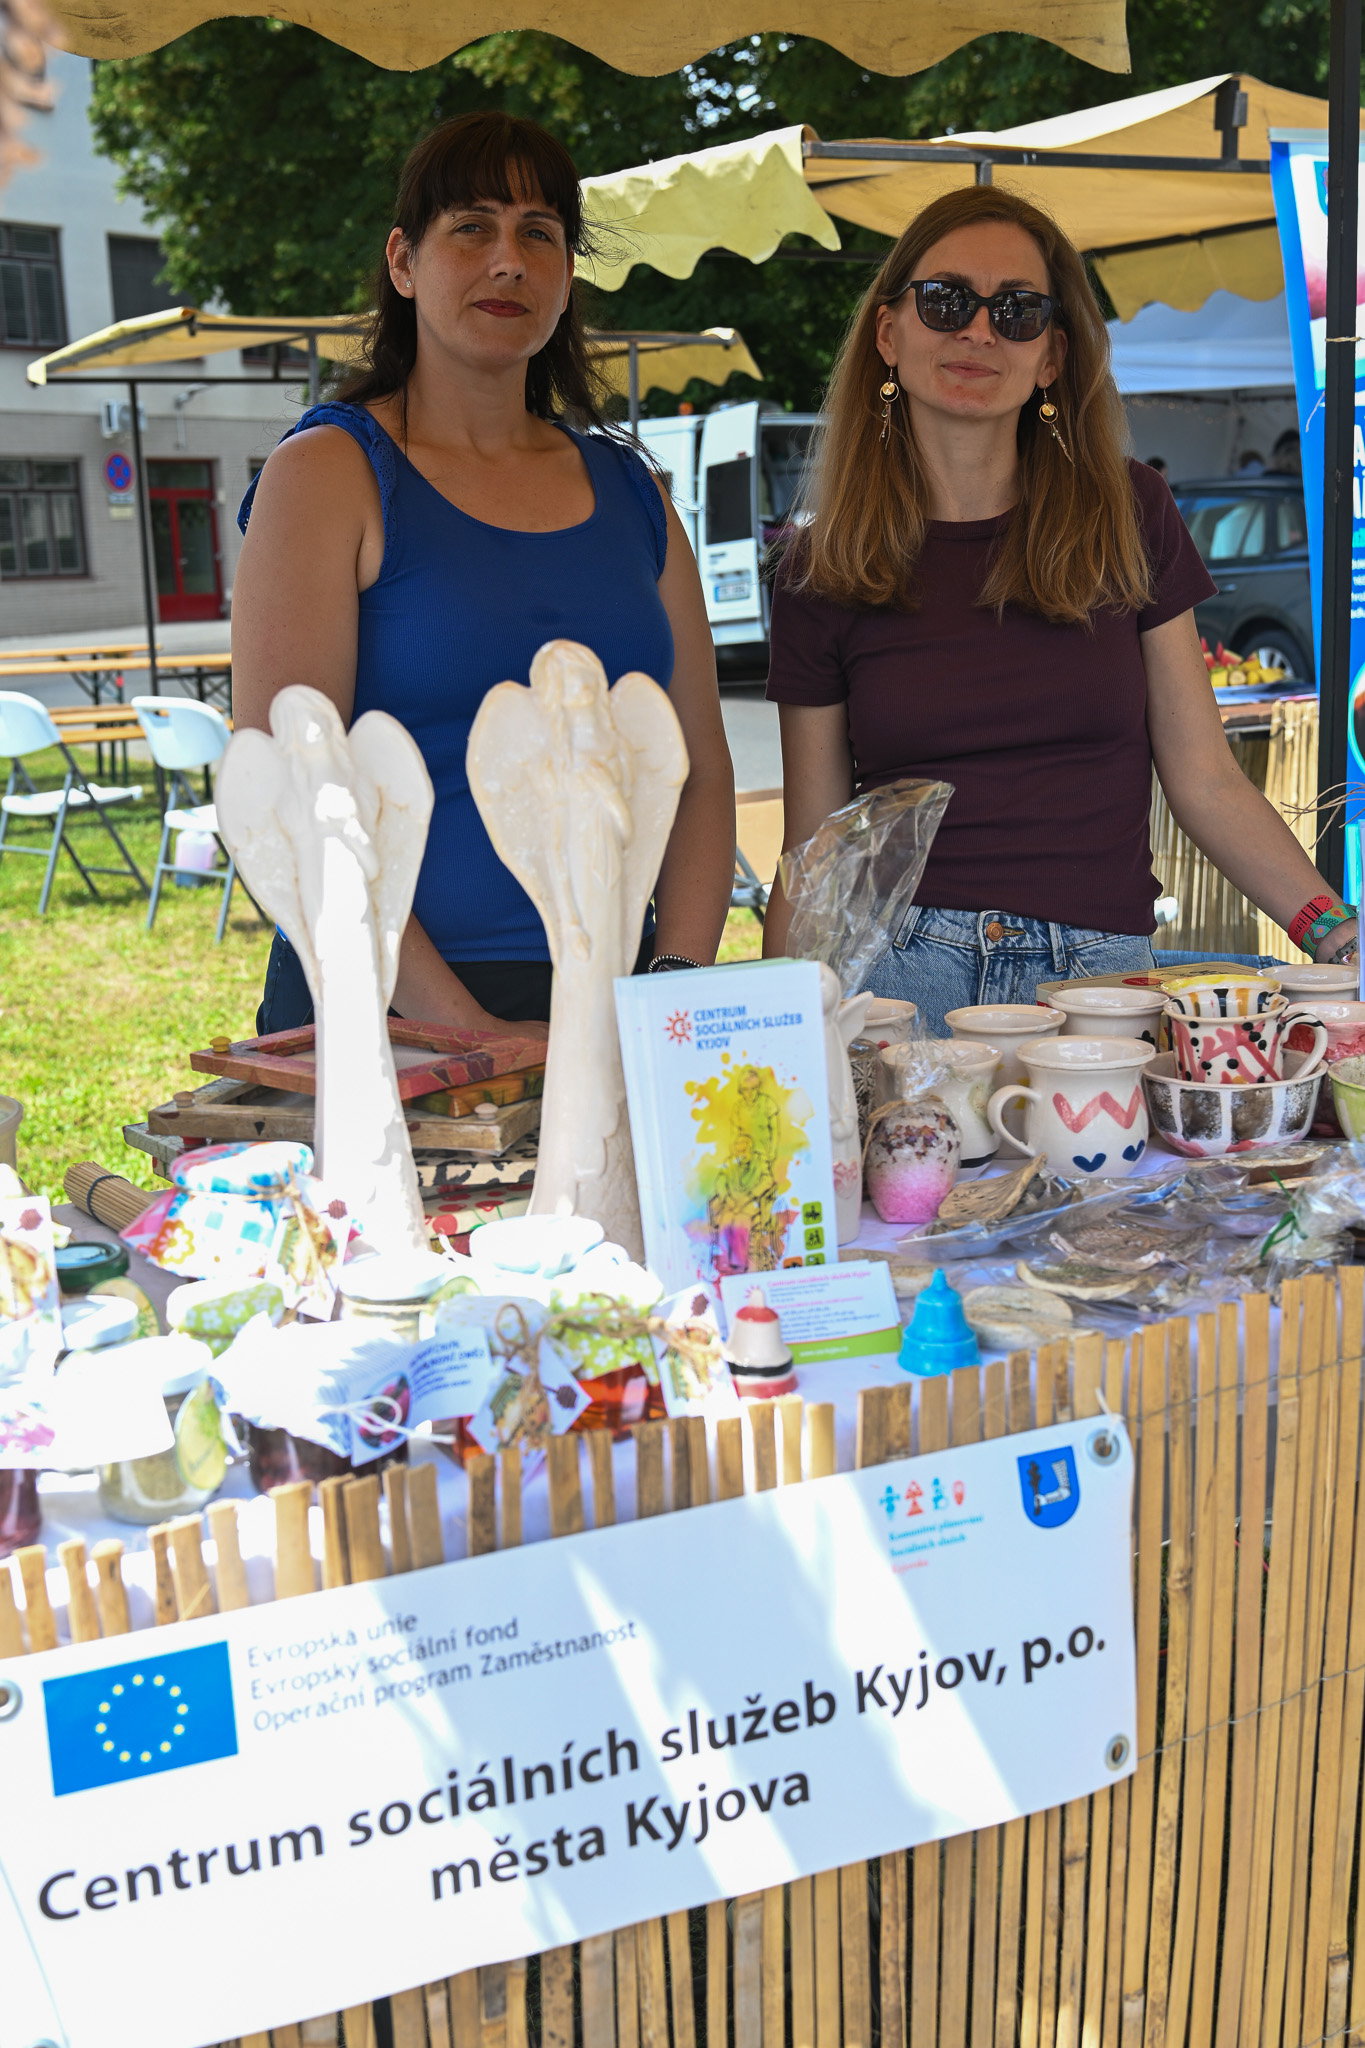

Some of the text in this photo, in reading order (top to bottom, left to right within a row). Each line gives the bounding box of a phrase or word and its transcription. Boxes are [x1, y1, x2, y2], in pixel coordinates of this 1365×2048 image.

[694, 1005, 746, 1021] CENTRUM
[695, 1017, 760, 1036] SOCIÁLNÍCH
[762, 1013, 803, 1028] SLUŽEB
[696, 1037, 731, 1050] KYJOV
[247, 1612, 418, 1668] Evropská unie
[251, 1618, 519, 1700] Evropský sociální fond
[254, 1620, 638, 1731] Operační program Zaměstnanost
[38, 1624, 1106, 1922] Centrum sociálních služeb Kyjov, p.o.
[431, 1768, 811, 1901] města Kyjova
